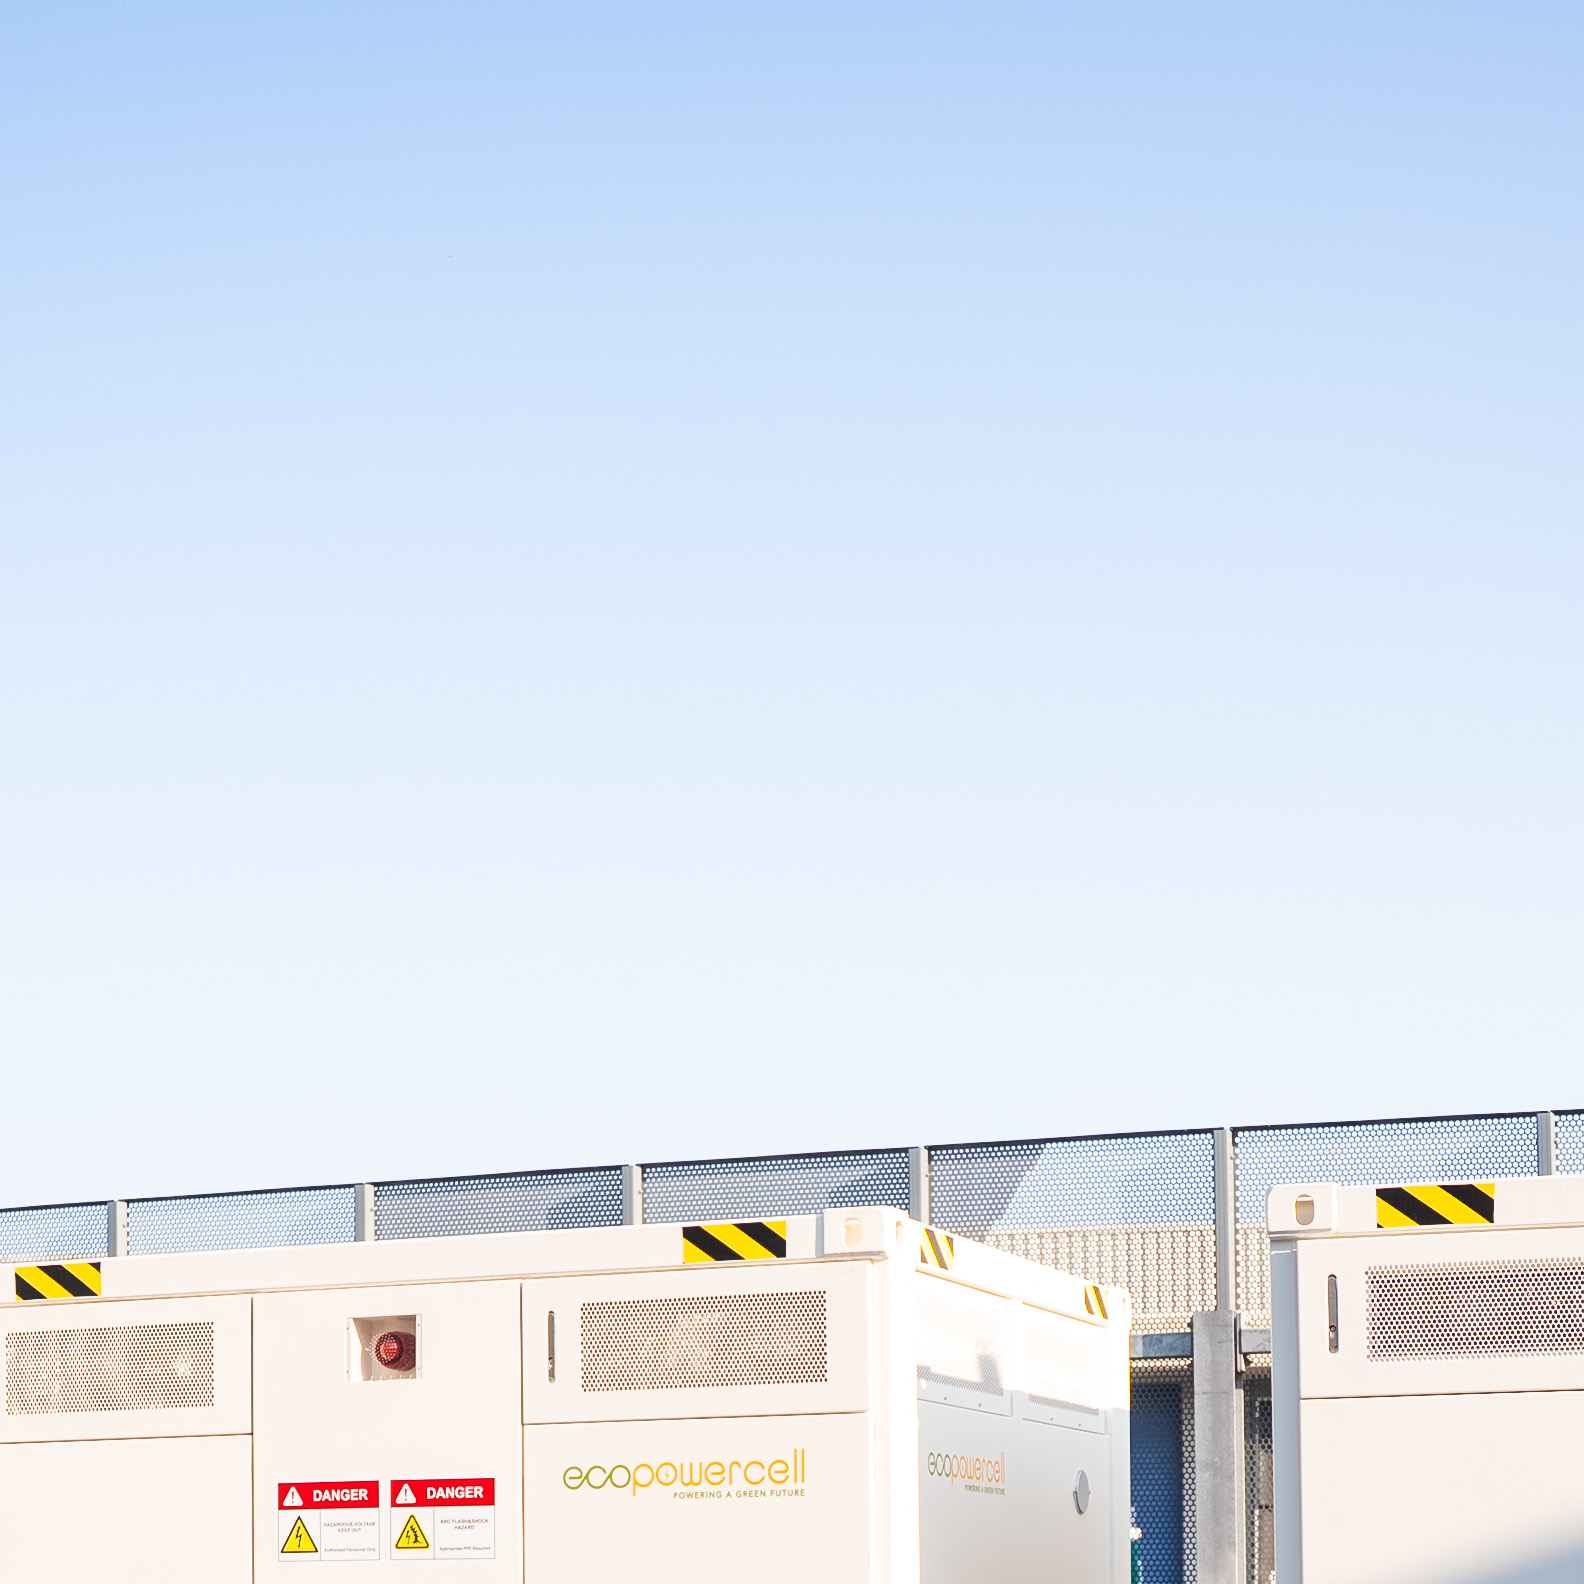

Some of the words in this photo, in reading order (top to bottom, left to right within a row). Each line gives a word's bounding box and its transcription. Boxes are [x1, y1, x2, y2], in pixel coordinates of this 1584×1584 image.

[563, 1448, 805, 1496] ecopowercell
[928, 1451, 1006, 1486] ecopowercell
[313, 1488, 369, 1502] DANGER
[426, 1485, 484, 1499] DANGER
[673, 1491, 722, 1499] POWERING
[725, 1490, 733, 1498] A
[735, 1490, 766, 1498] GREEN
[770, 1489, 805, 1497] FUTURE
